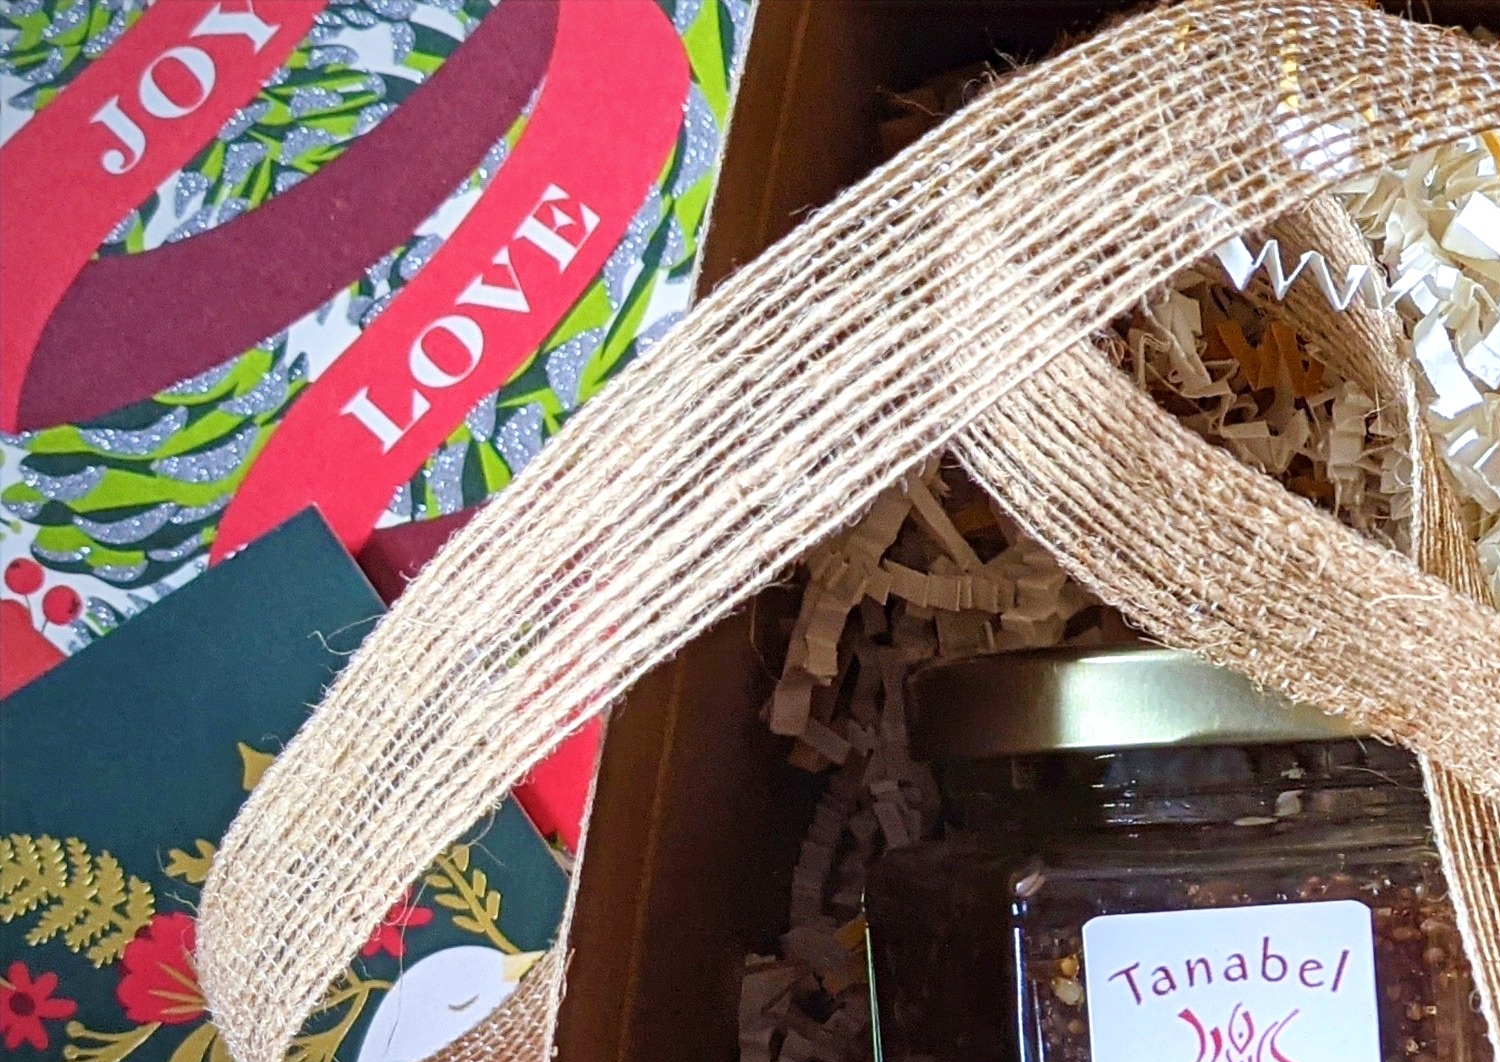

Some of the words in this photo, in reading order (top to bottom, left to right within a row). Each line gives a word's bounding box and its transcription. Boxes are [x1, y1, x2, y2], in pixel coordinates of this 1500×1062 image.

[89, 0, 281, 175] JOY
[341, 183, 601, 454] LOVE
[1108, 936, 1350, 1005] Tanabel
